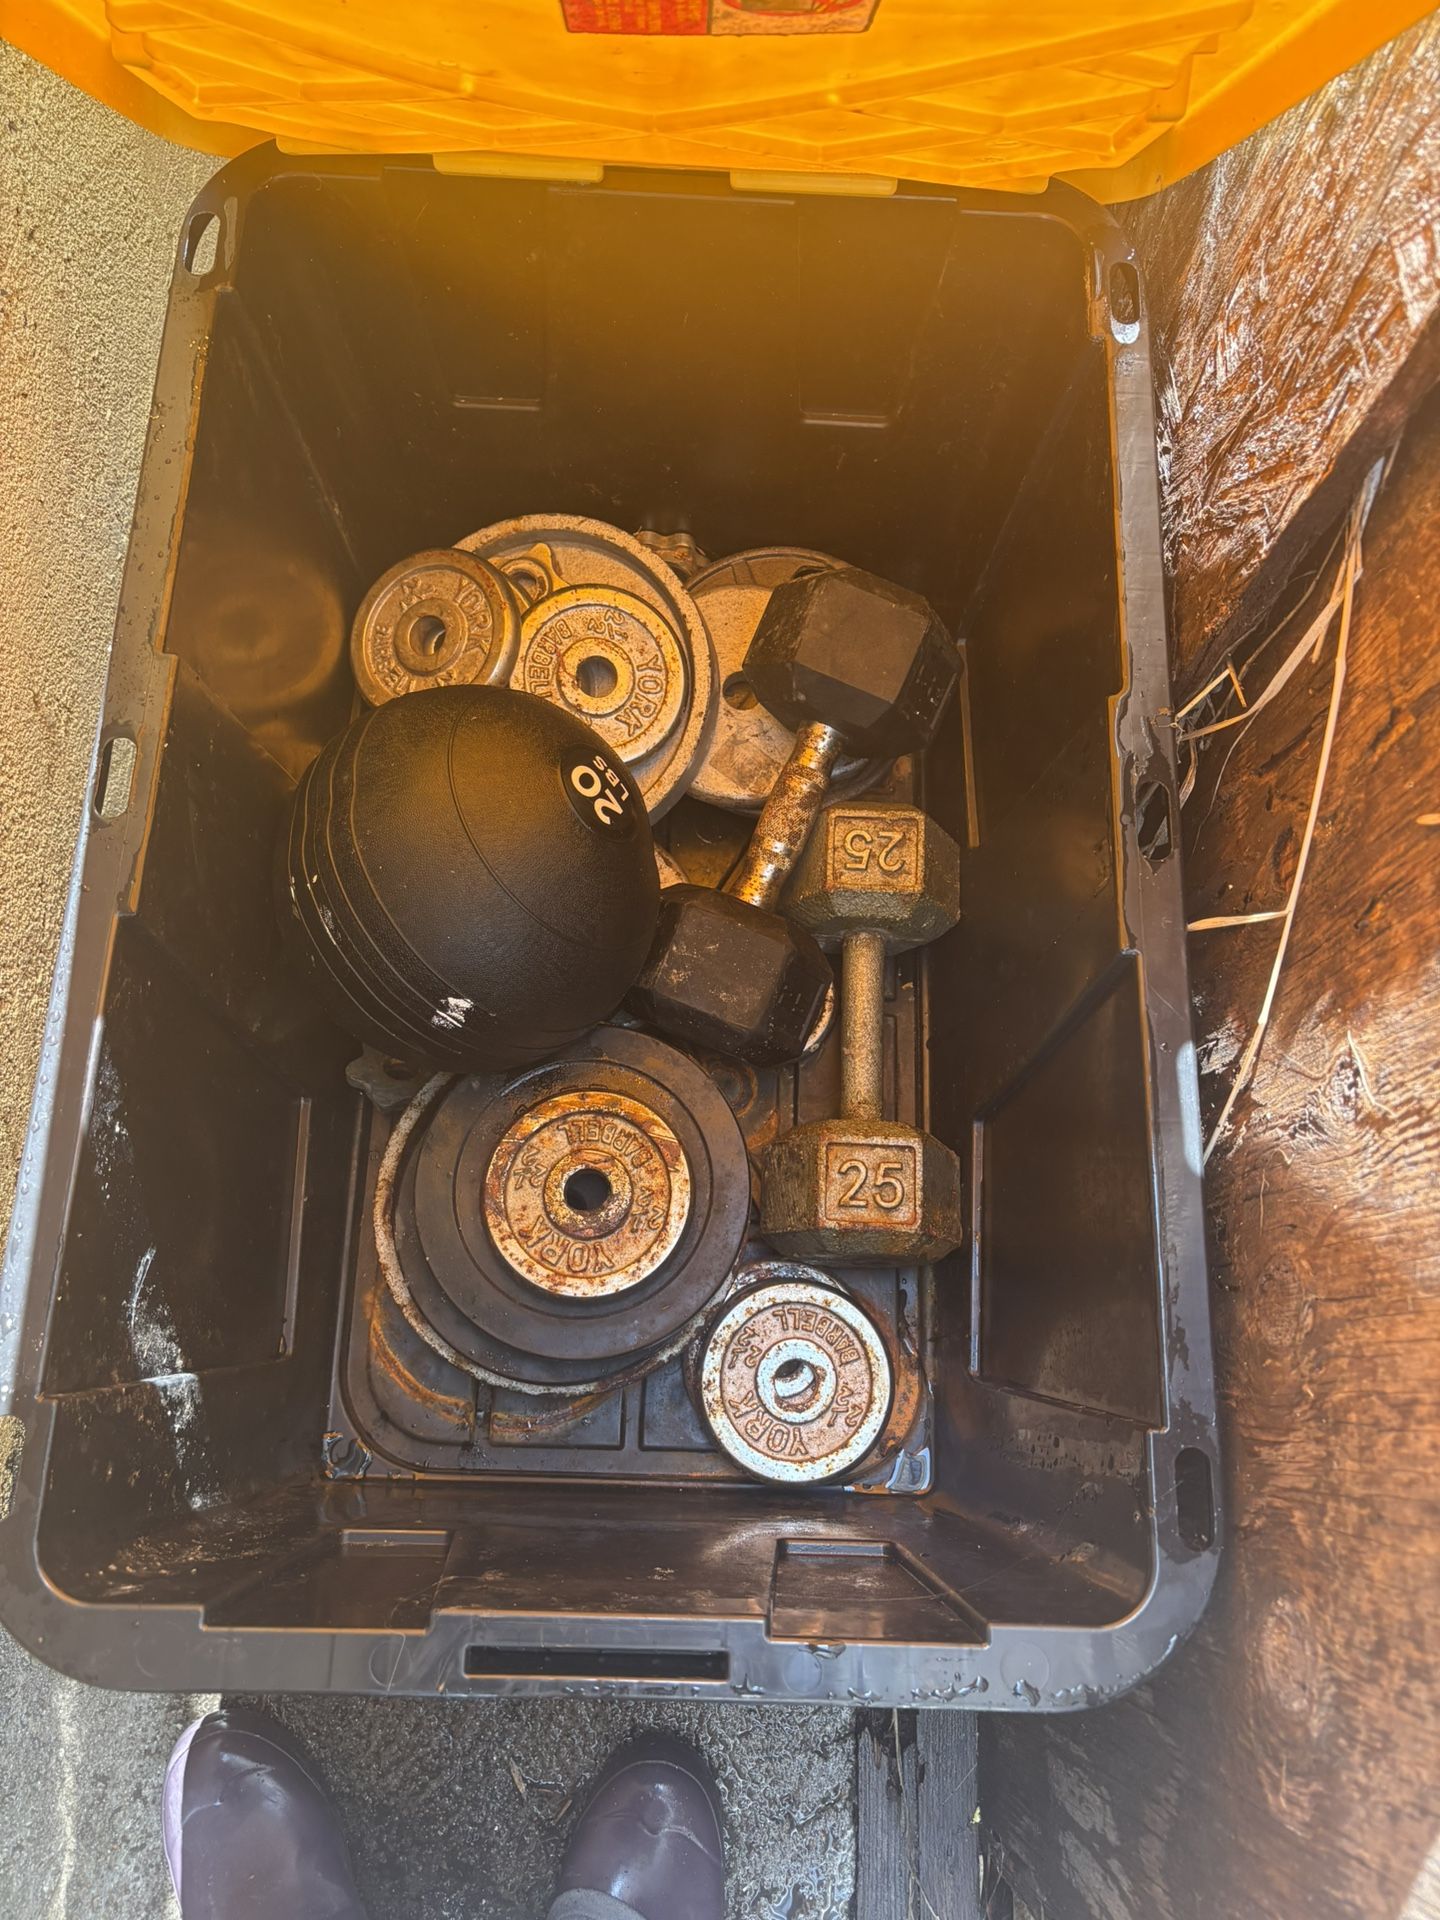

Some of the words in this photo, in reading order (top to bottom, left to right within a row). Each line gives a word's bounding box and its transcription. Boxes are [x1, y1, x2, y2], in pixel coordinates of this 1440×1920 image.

[453, 576, 493, 656] YORK
[614, 654, 663, 738] YORK
[570, 764, 625, 826] 20
[594, 754, 630, 802] LBS
[844, 828, 907, 873] 25
[557, 1119, 653, 1170] BARBELL
[837, 1158, 906, 1210] 25
[518, 1215, 615, 1273] YORK
[772, 1307, 861, 1366] BARBELL
[728, 1390, 810, 1457] YORK
